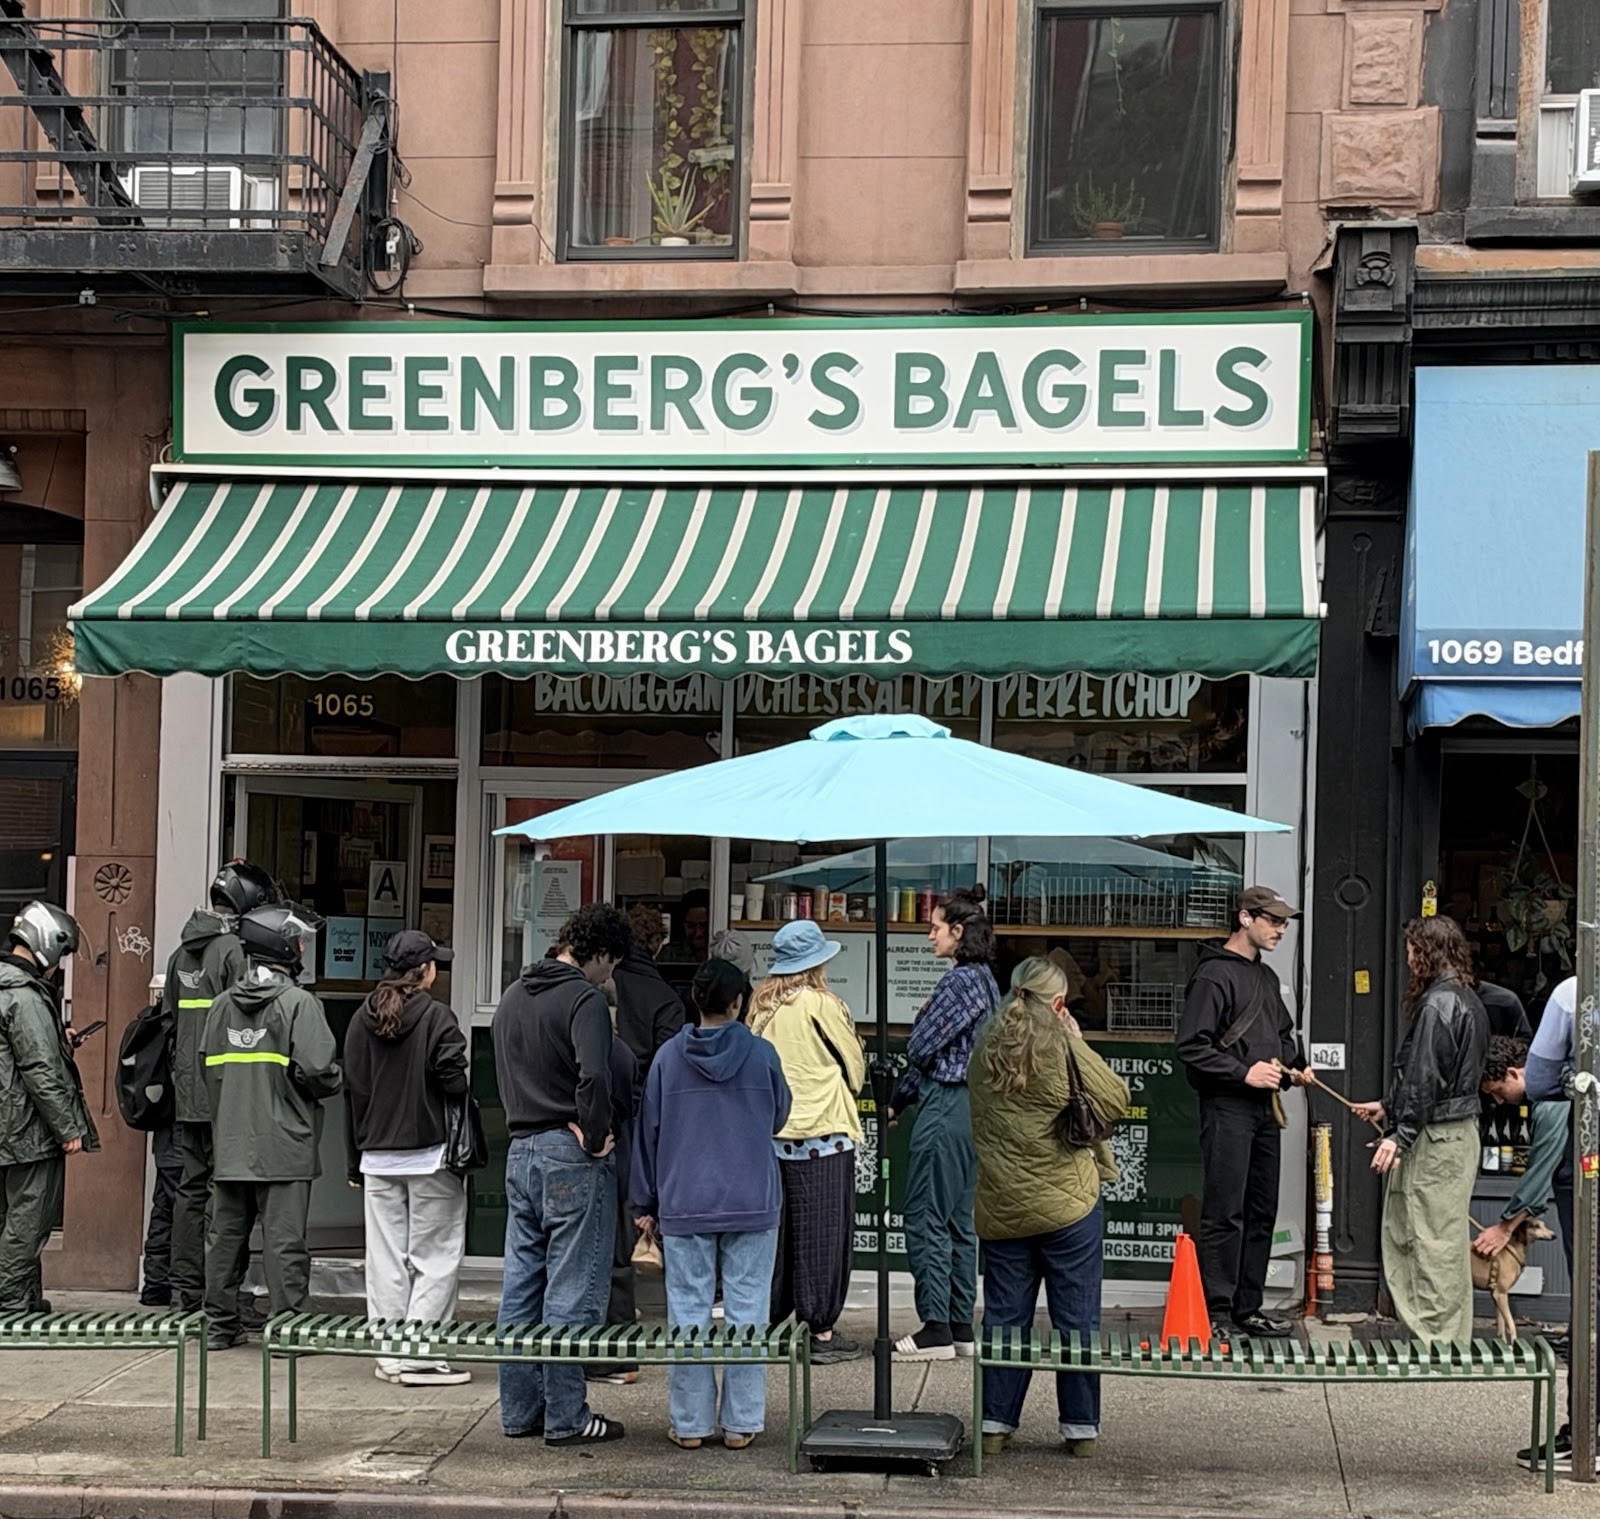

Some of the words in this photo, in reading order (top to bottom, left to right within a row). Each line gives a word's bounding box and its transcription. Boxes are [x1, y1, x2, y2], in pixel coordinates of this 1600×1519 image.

[214, 352, 862, 433] GREENBERG'S
[894, 347, 1271, 429] BAGELS
[445, 629, 737, 664] GREENBERG'S
[745, 629, 913, 664] BAGELS
[1428, 639, 1502, 665] 1069
[0, 677, 60, 700] 1065
[314, 693, 374, 716] 1065
[373, 867, 398, 901] A
[886, 946, 919, 954] ALREADY
[1106, 1221, 1135, 1235] 8AM
[1137, 1222, 1153, 1236] till
[1155, 1223, 1184, 1237] 3PM
